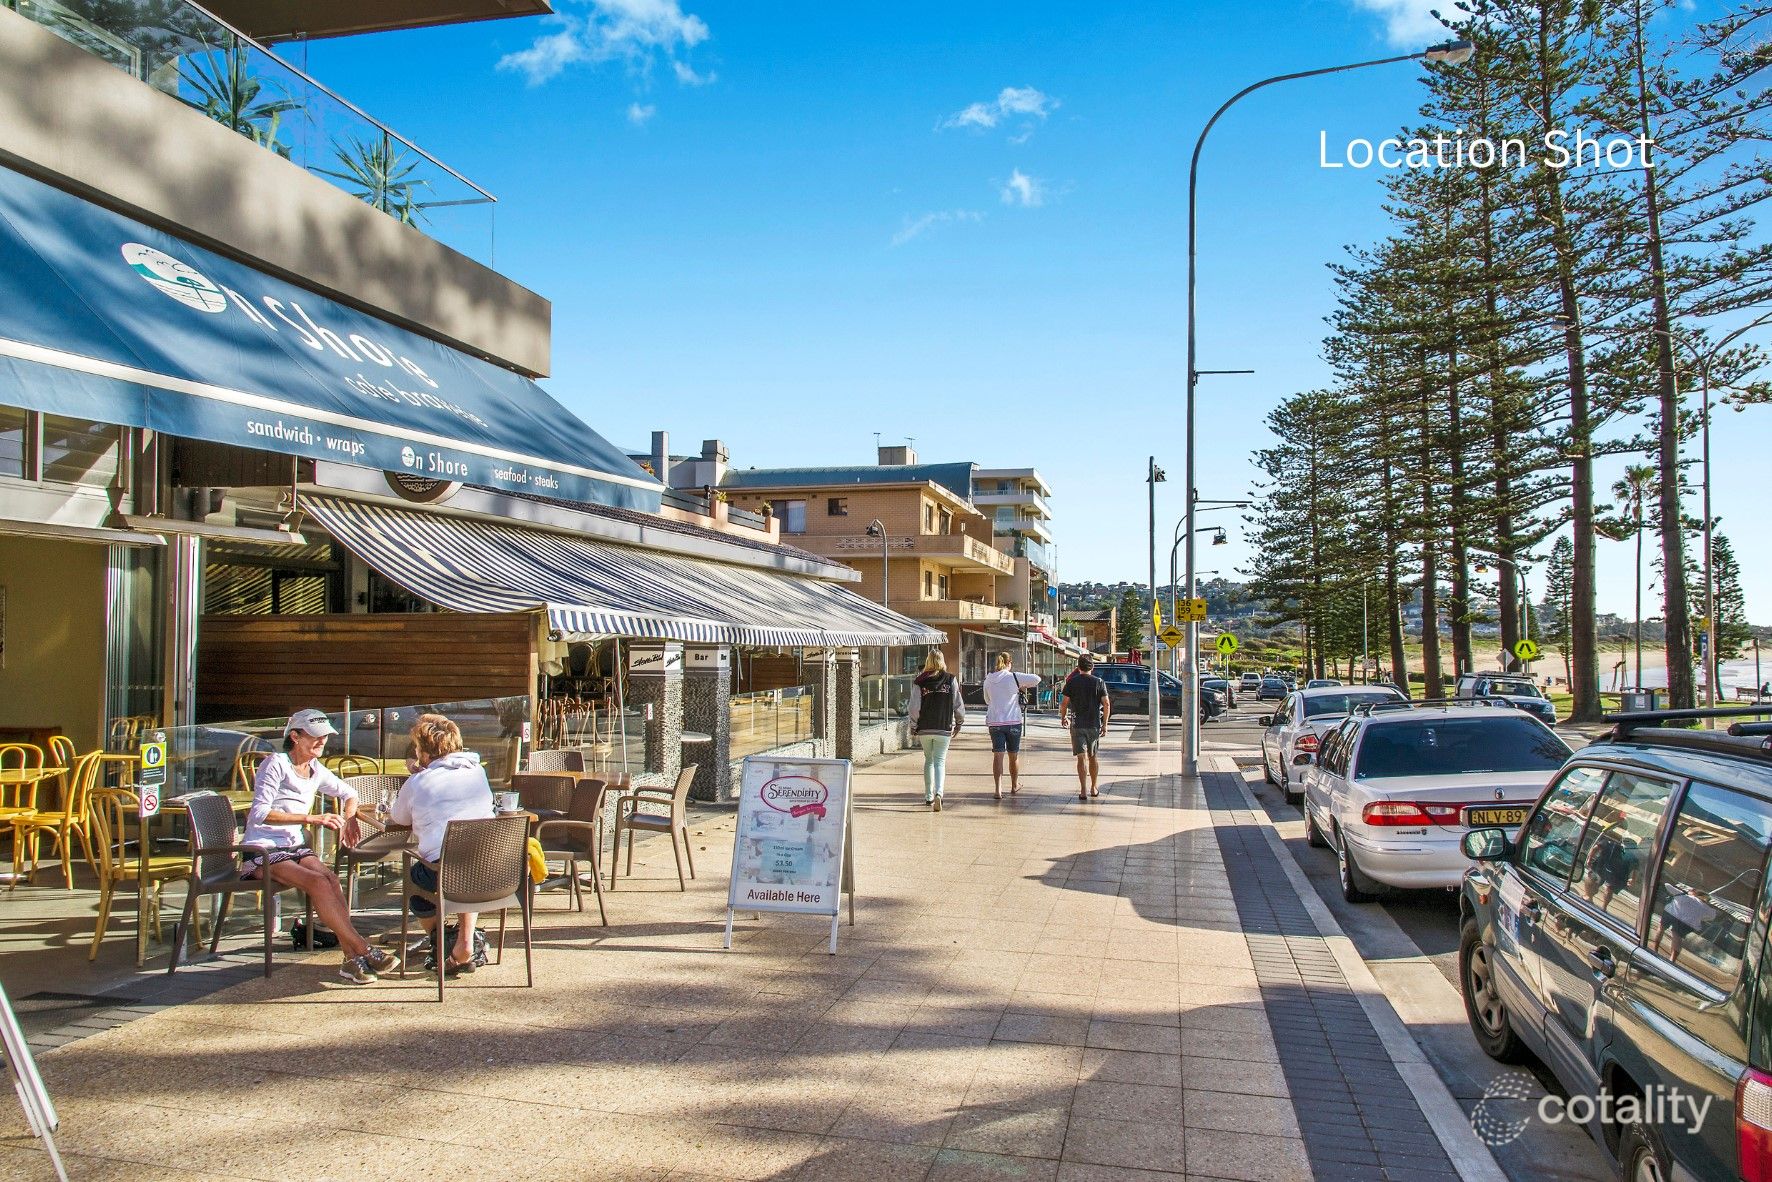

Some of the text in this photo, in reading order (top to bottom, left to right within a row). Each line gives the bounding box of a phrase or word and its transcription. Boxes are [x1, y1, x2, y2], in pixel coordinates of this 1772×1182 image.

[263, 296, 439, 388] Shore
[247, 420, 365, 457] sandwich wraps
[401, 446, 468, 477] On Shore
[494, 467, 559, 490] seafood steaks
[694, 653, 709, 661] Bar
[747, 889, 821, 903] Available Here
